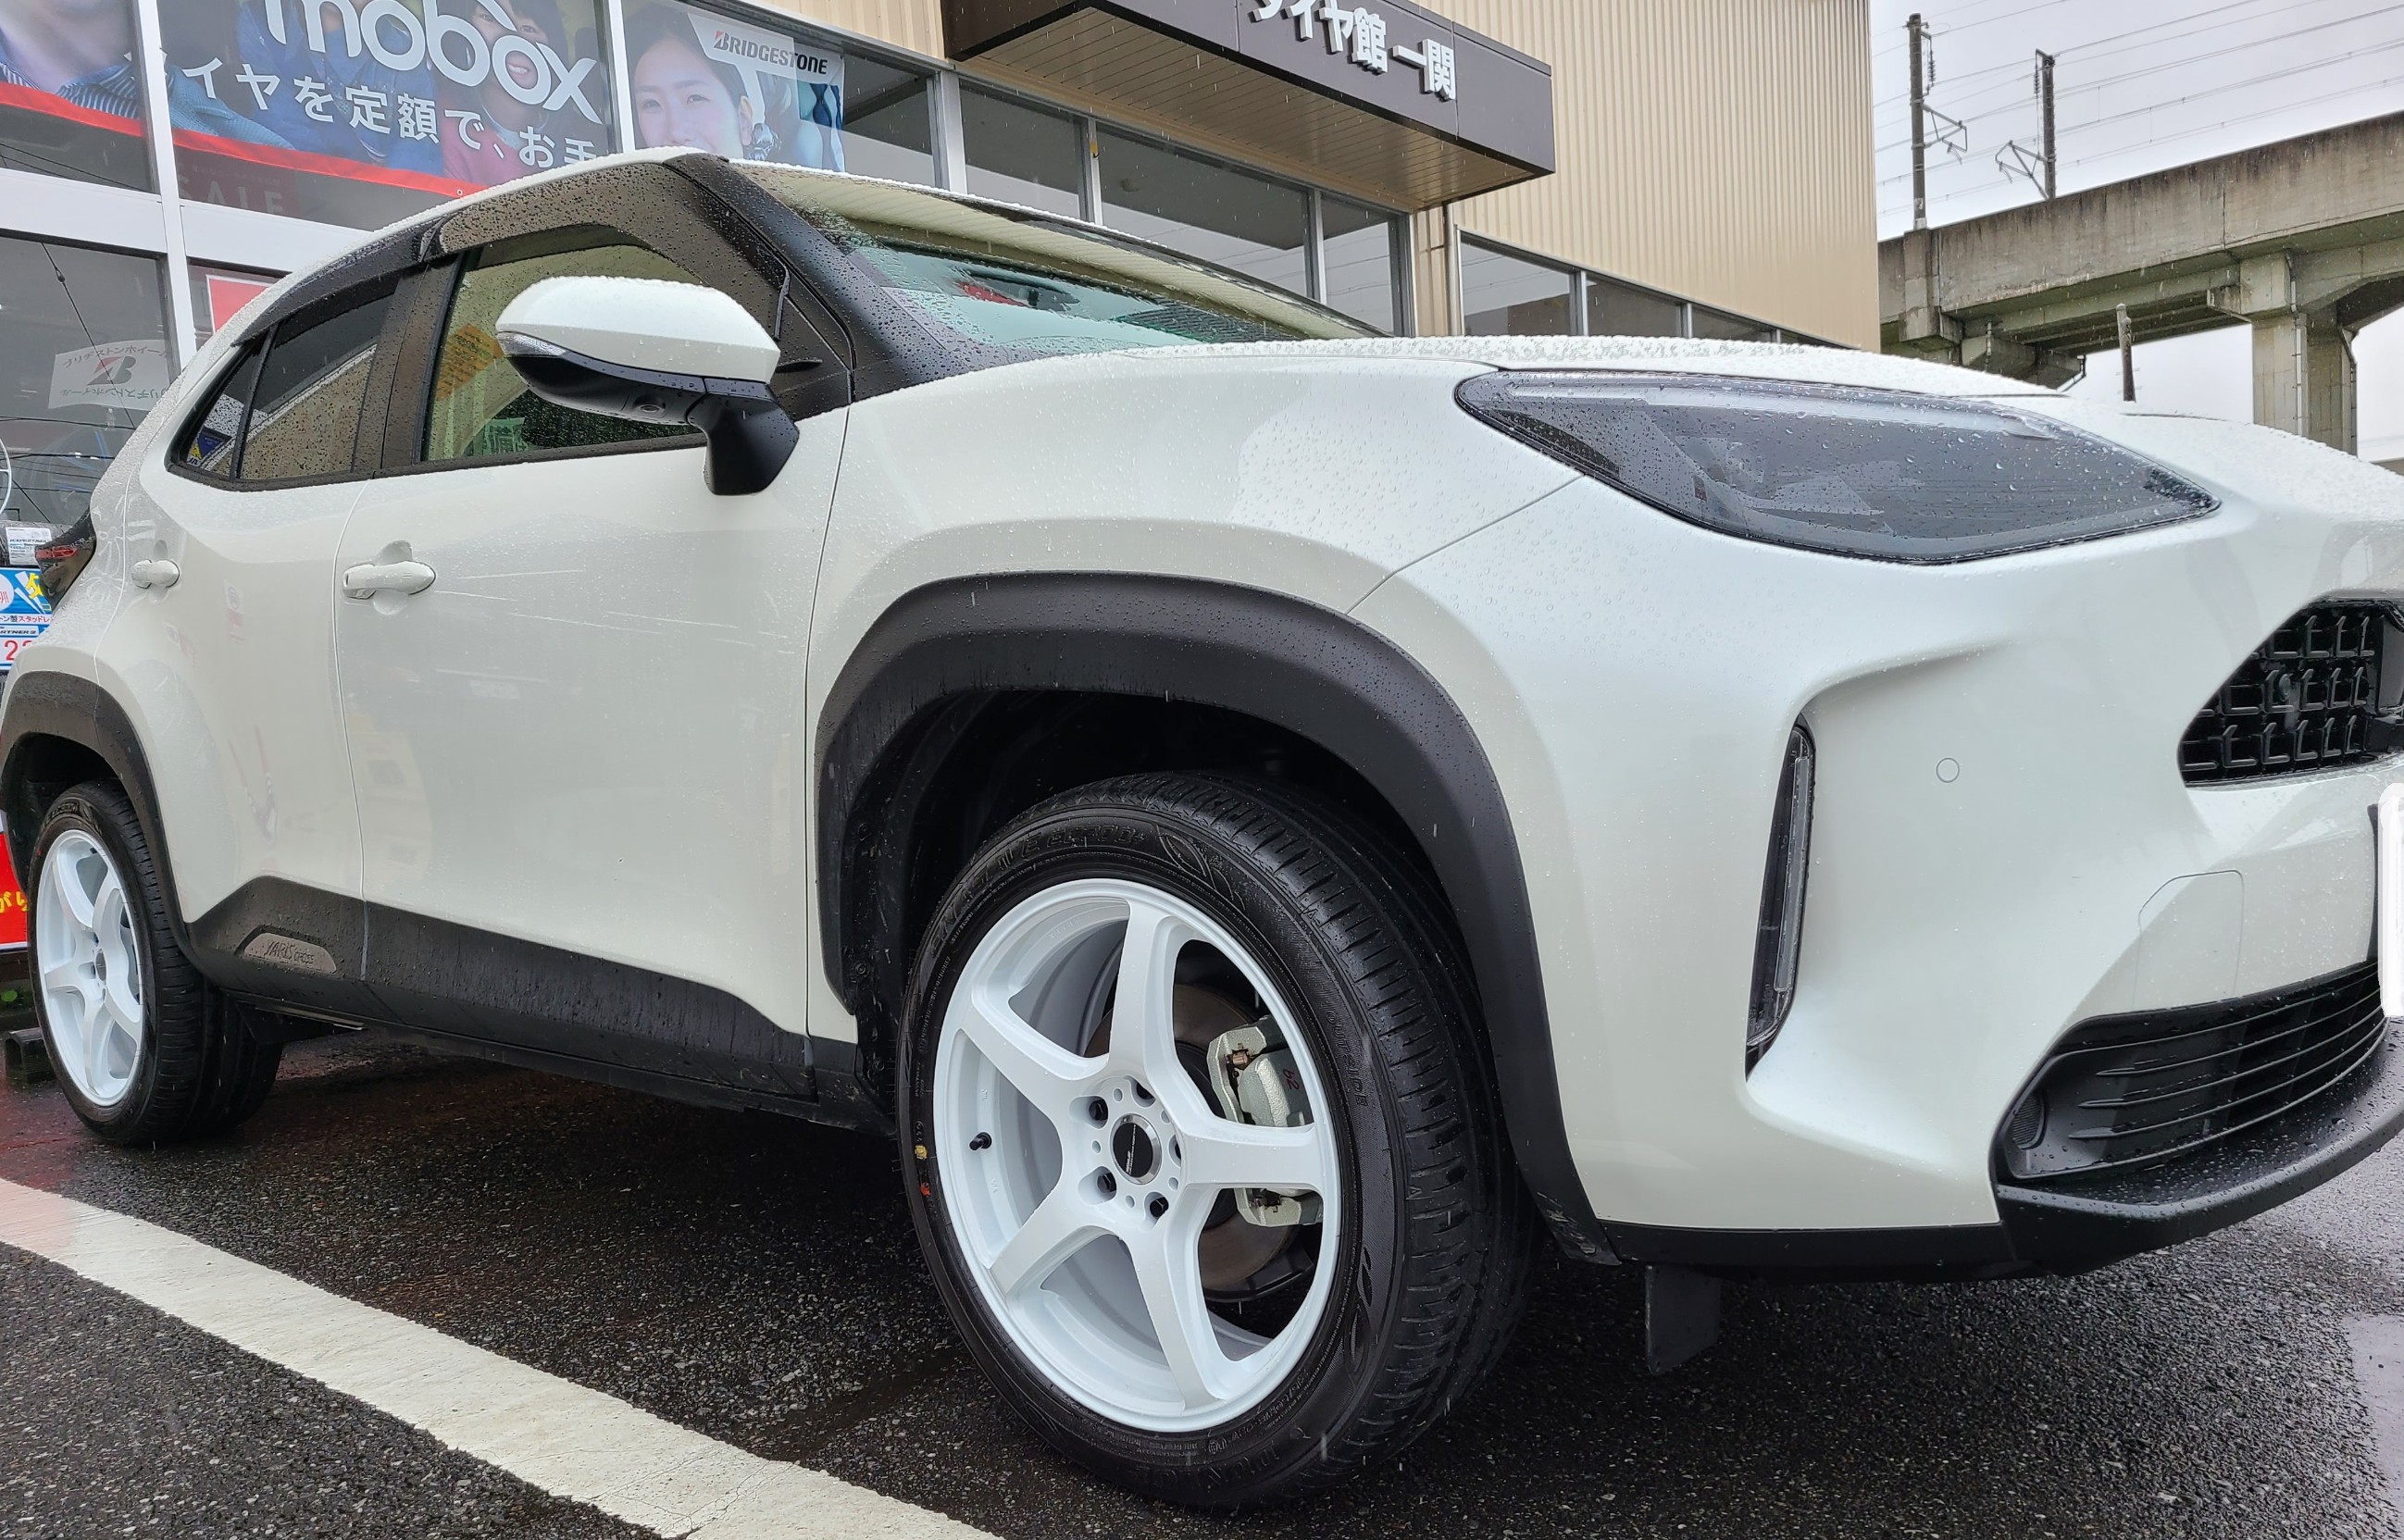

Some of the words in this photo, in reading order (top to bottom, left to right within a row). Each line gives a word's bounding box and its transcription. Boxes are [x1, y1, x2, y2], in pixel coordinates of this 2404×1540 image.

[263, 0, 602, 124] mobox
[713, 30, 828, 75] BRIDGESTONE
[123, 51, 599, 168] イヤを定額で、お手
[263, 939, 295, 961] YARIS
